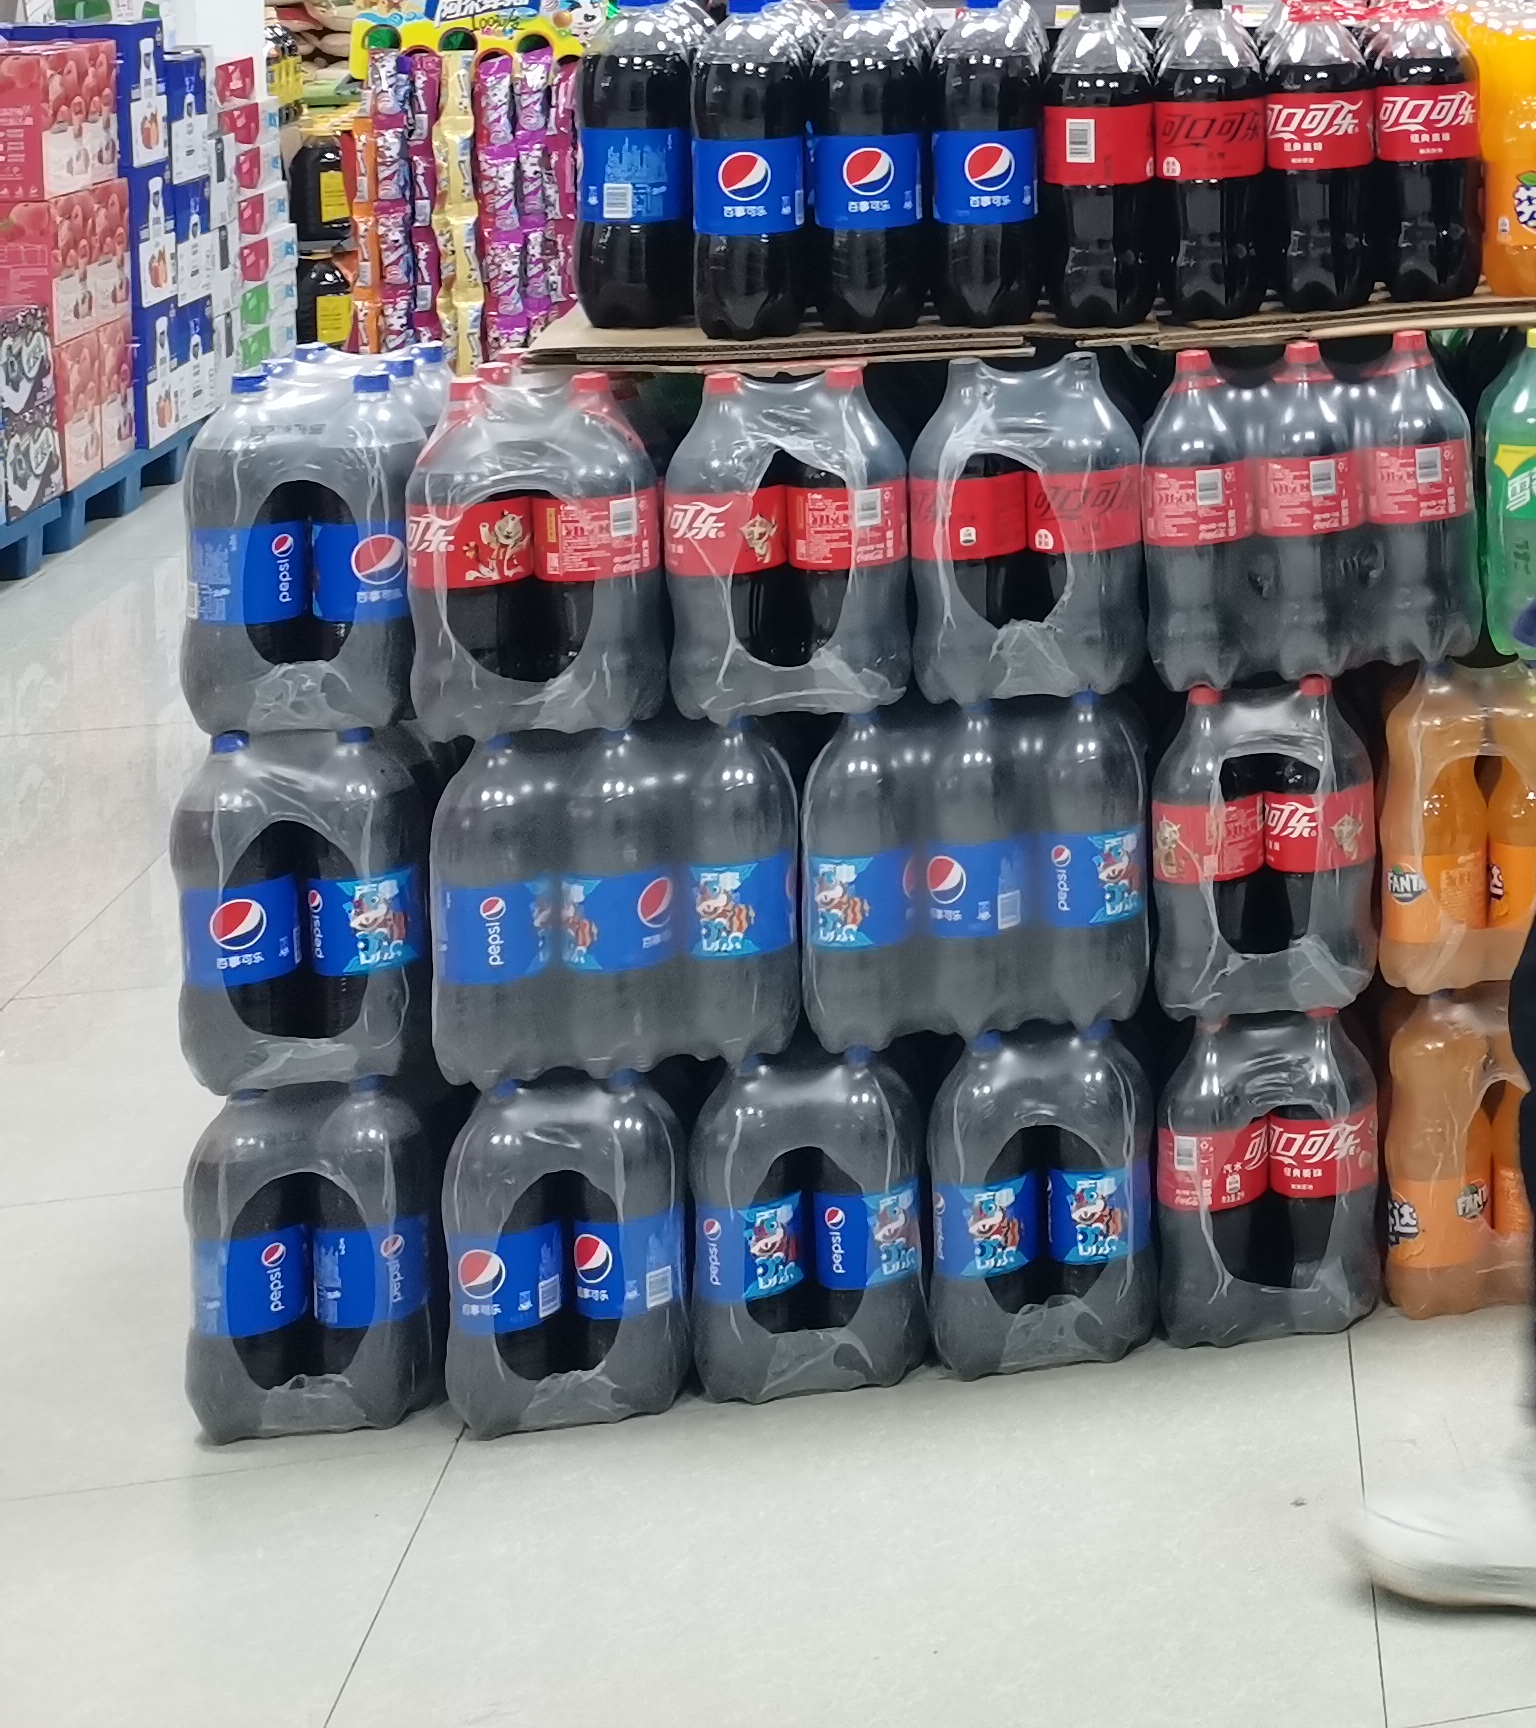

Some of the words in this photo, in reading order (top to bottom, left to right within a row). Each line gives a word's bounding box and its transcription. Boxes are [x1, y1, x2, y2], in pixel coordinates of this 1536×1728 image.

[276, 555, 292, 604] pepsi
[1053, 866, 1070, 914] pepsi
[1388, 872, 1427, 895] FANTA
[484, 921, 505, 967] pepsi
[706, 1239, 721, 1286] pepsi
[831, 1229, 846, 1276] pepsi
[268, 1265, 286, 1312] pepsi
[390, 1257, 405, 1304] pepsi
